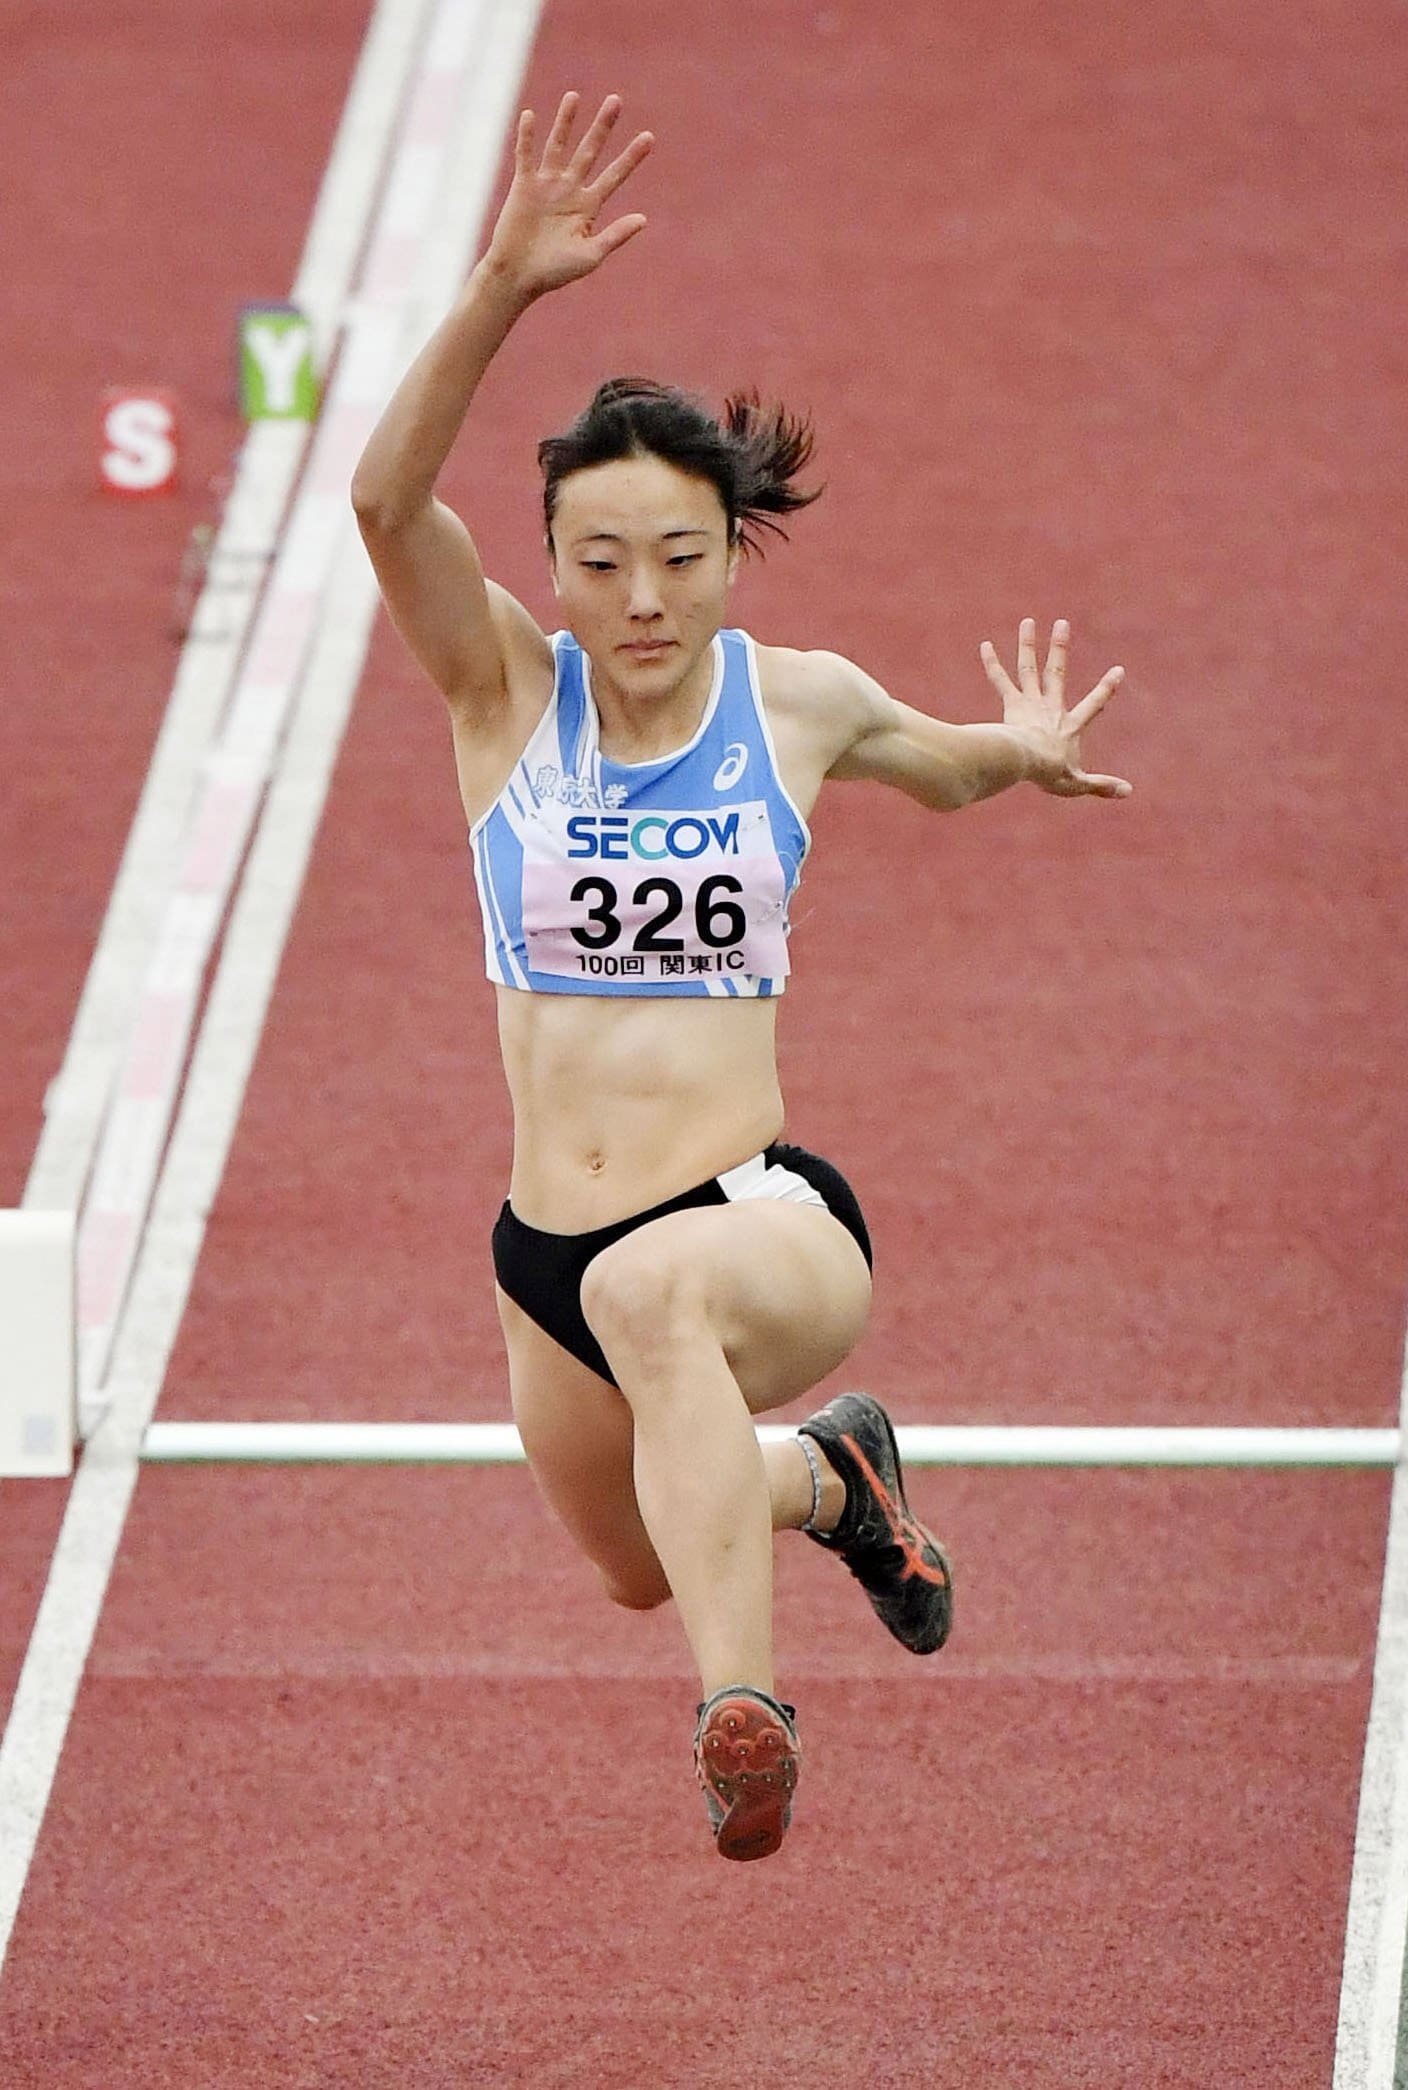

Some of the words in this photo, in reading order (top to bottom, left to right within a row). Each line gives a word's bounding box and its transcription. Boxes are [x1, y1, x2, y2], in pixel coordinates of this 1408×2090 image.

[247, 325, 309, 412] Y
[101, 398, 177, 490] S
[569, 873, 746, 952] 326
[575, 953, 645, 977] 100回
